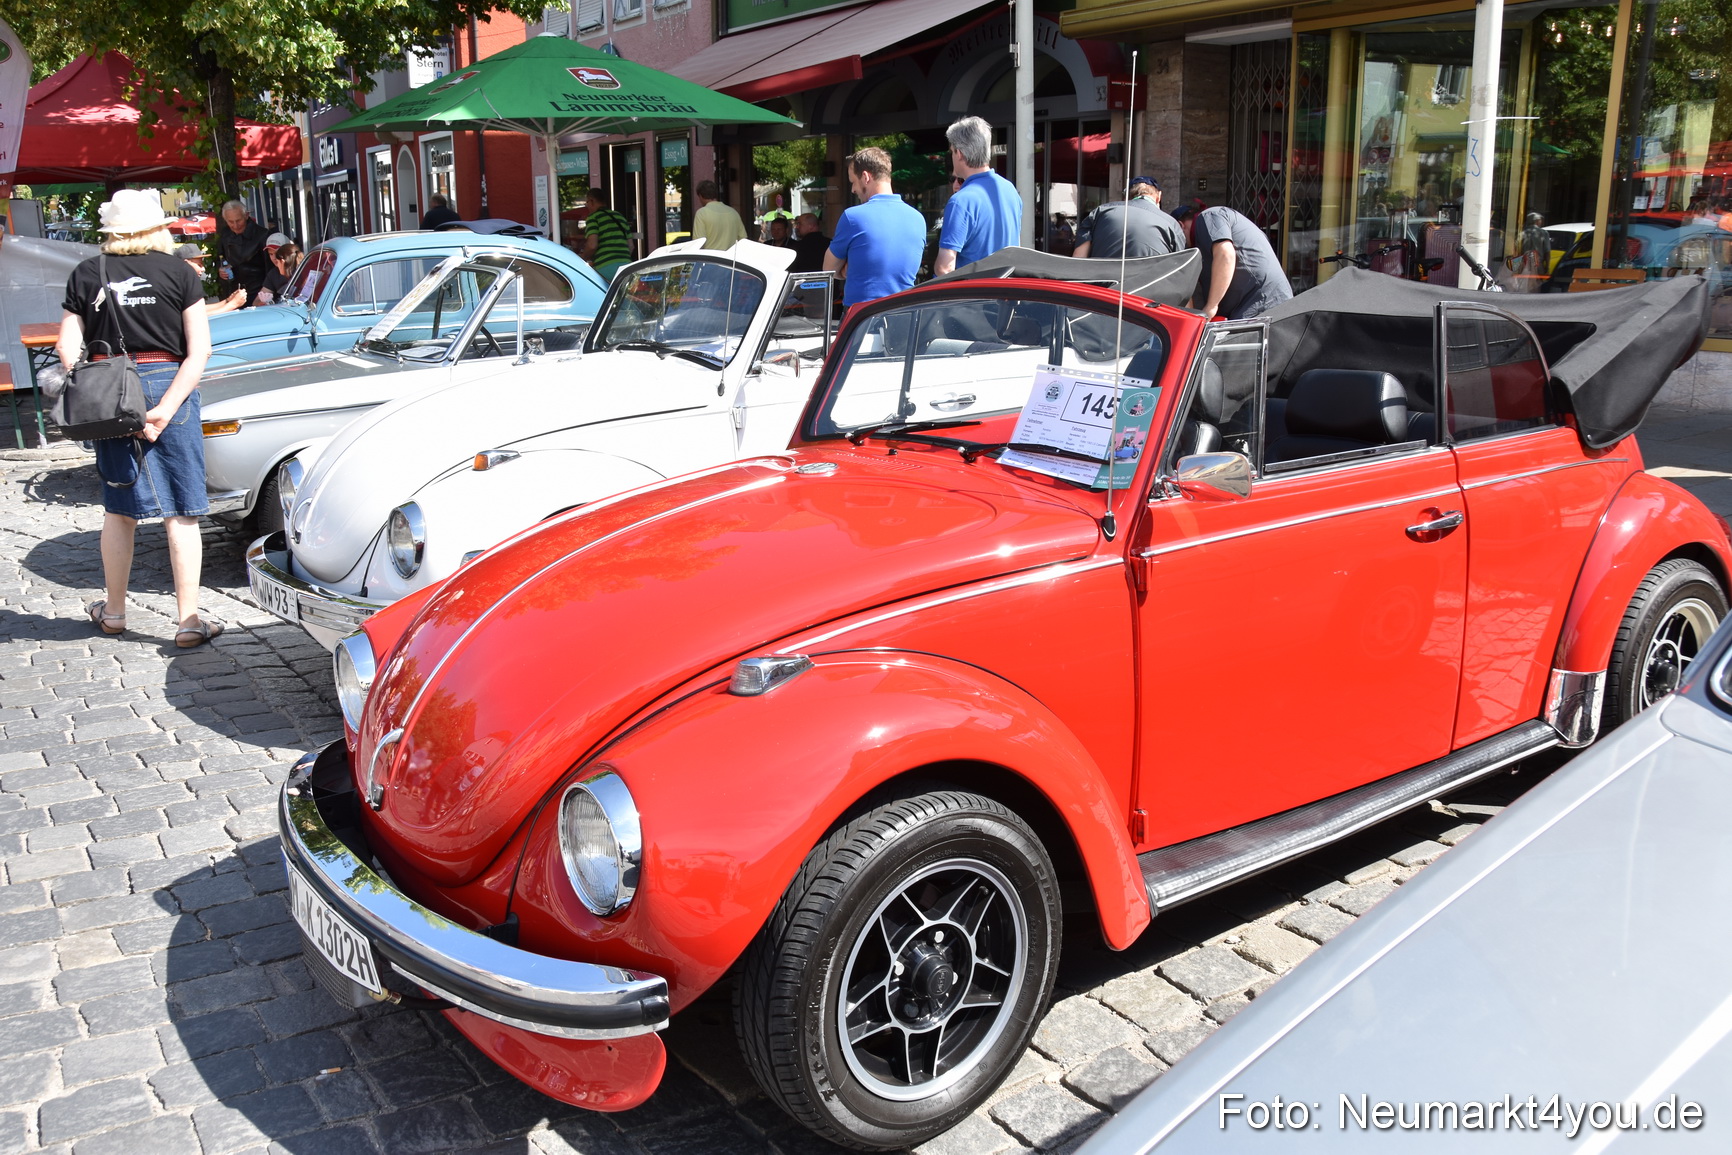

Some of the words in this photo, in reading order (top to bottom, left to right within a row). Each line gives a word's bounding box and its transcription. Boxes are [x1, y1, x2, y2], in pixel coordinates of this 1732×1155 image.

[417, 58, 444, 68] Stern
[562, 93, 666, 102] Neumarkter
[550, 101, 698, 113] Lammsbräu
[121, 296, 156, 307] Express
[1081, 392, 1121, 420] 145
[274, 586, 289, 615] 93
